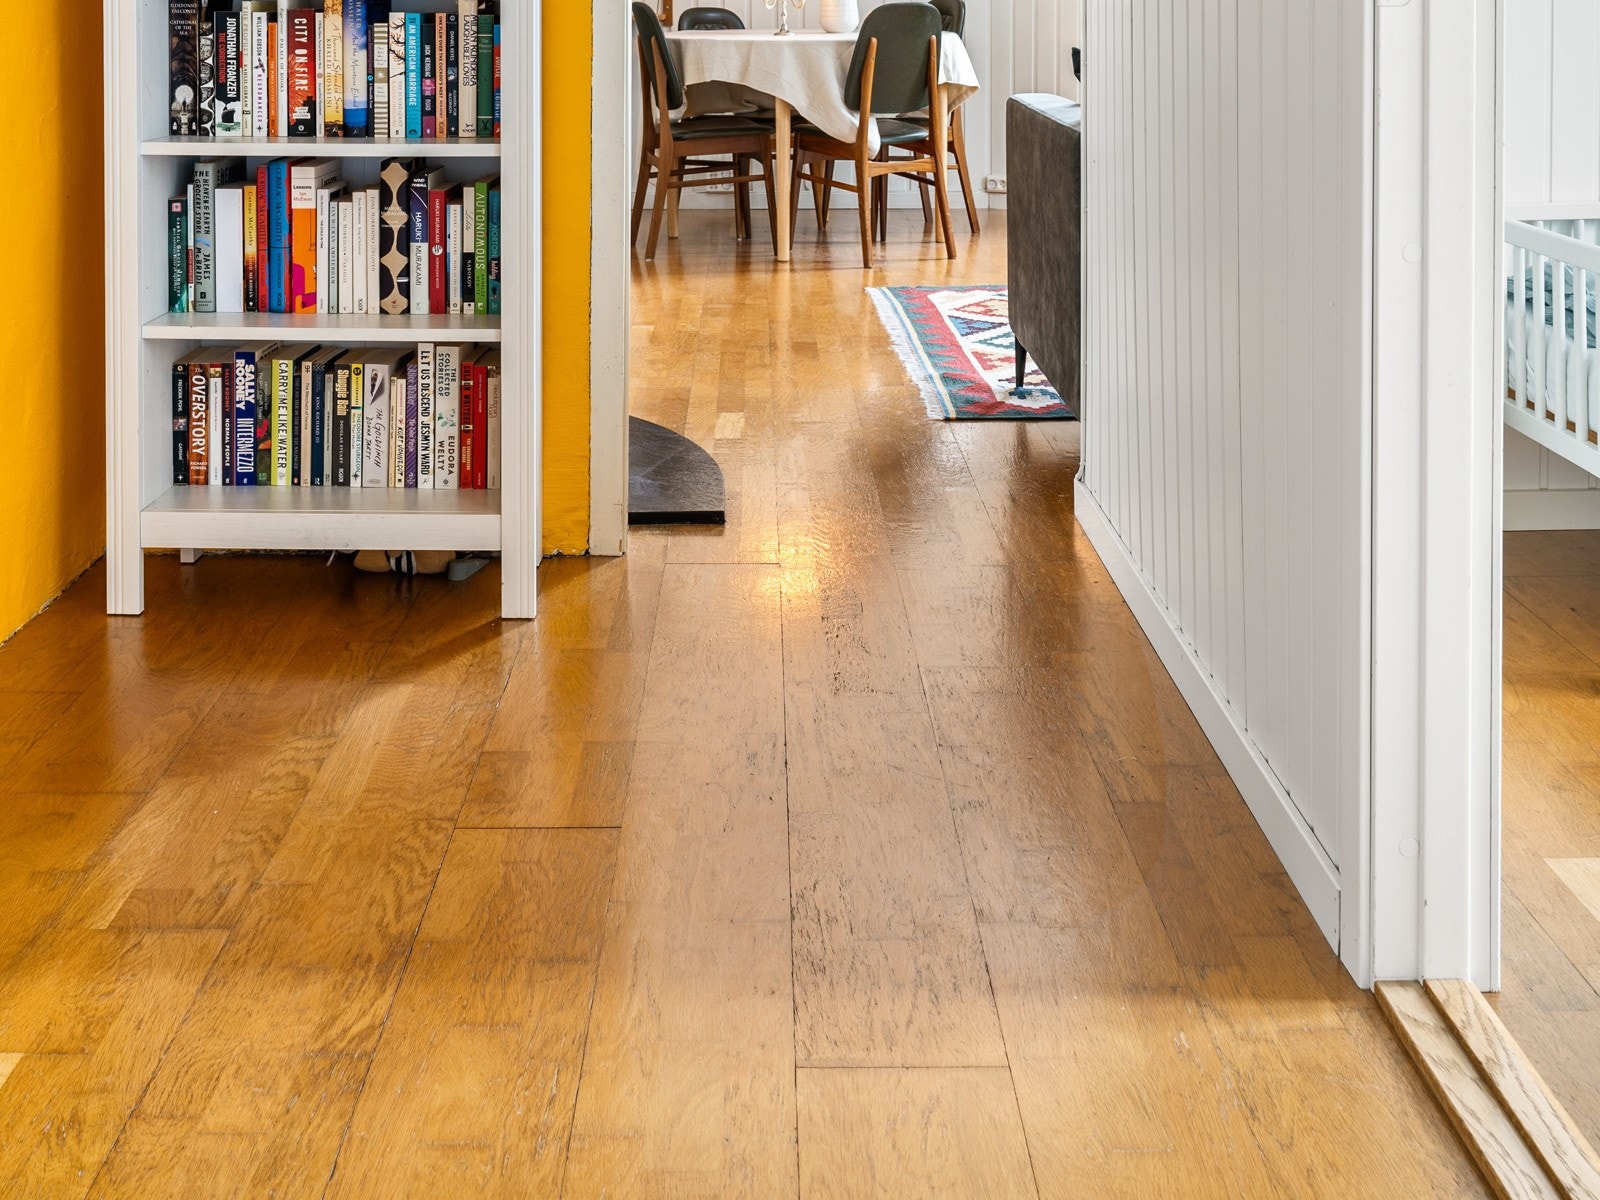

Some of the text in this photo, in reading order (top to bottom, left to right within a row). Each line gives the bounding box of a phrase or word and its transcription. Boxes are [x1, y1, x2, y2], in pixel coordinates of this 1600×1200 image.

[294, 18, 307, 42] CITY
[408, 24, 416, 33] AN
[470, 14, 478, 87] MILAN KUNDERA
[226, 17, 237, 97] JONATHAN FRANZEN
[295, 48, 308, 63] ON
[295, 67, 308, 91] FIRE
[409, 72, 417, 106] MARRIAGE
[476, 193, 485, 269] AUTONOMOUS
[236, 359, 245, 410] ROONEY
[245, 364, 255, 403] SALLY
[335, 369, 349, 416] Shuggie Bain
[421, 350, 430, 417] LET US DESCEND
[438, 386, 444, 397] OF
[192, 375, 206, 455] OVERSTORY
[278, 362, 288, 468] CARRY ME LIKE WATER
[237, 418, 254, 472] INTERMEZZO
[421, 420, 430, 475] JESMYN WARD
